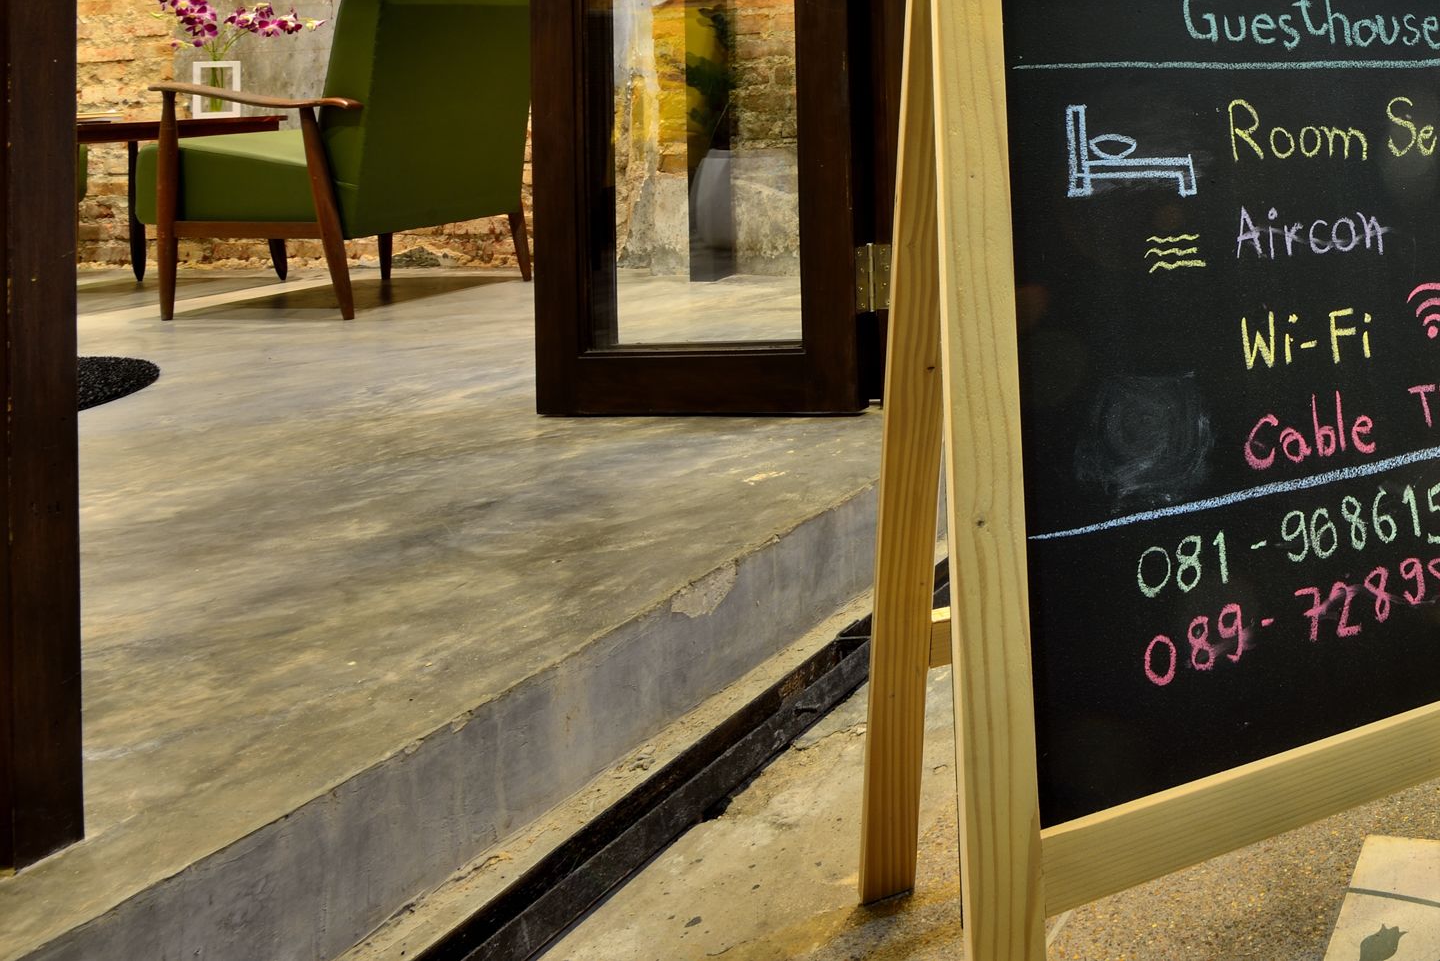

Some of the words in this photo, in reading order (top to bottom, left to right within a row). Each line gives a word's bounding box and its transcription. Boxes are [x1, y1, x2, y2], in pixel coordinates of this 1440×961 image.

[1227, 98, 1369, 162] Room
[1235, 205, 1388, 259] Aircon
[1241, 308, 1373, 370] Wi-Fi
[1244, 391, 1376, 470] Cable
